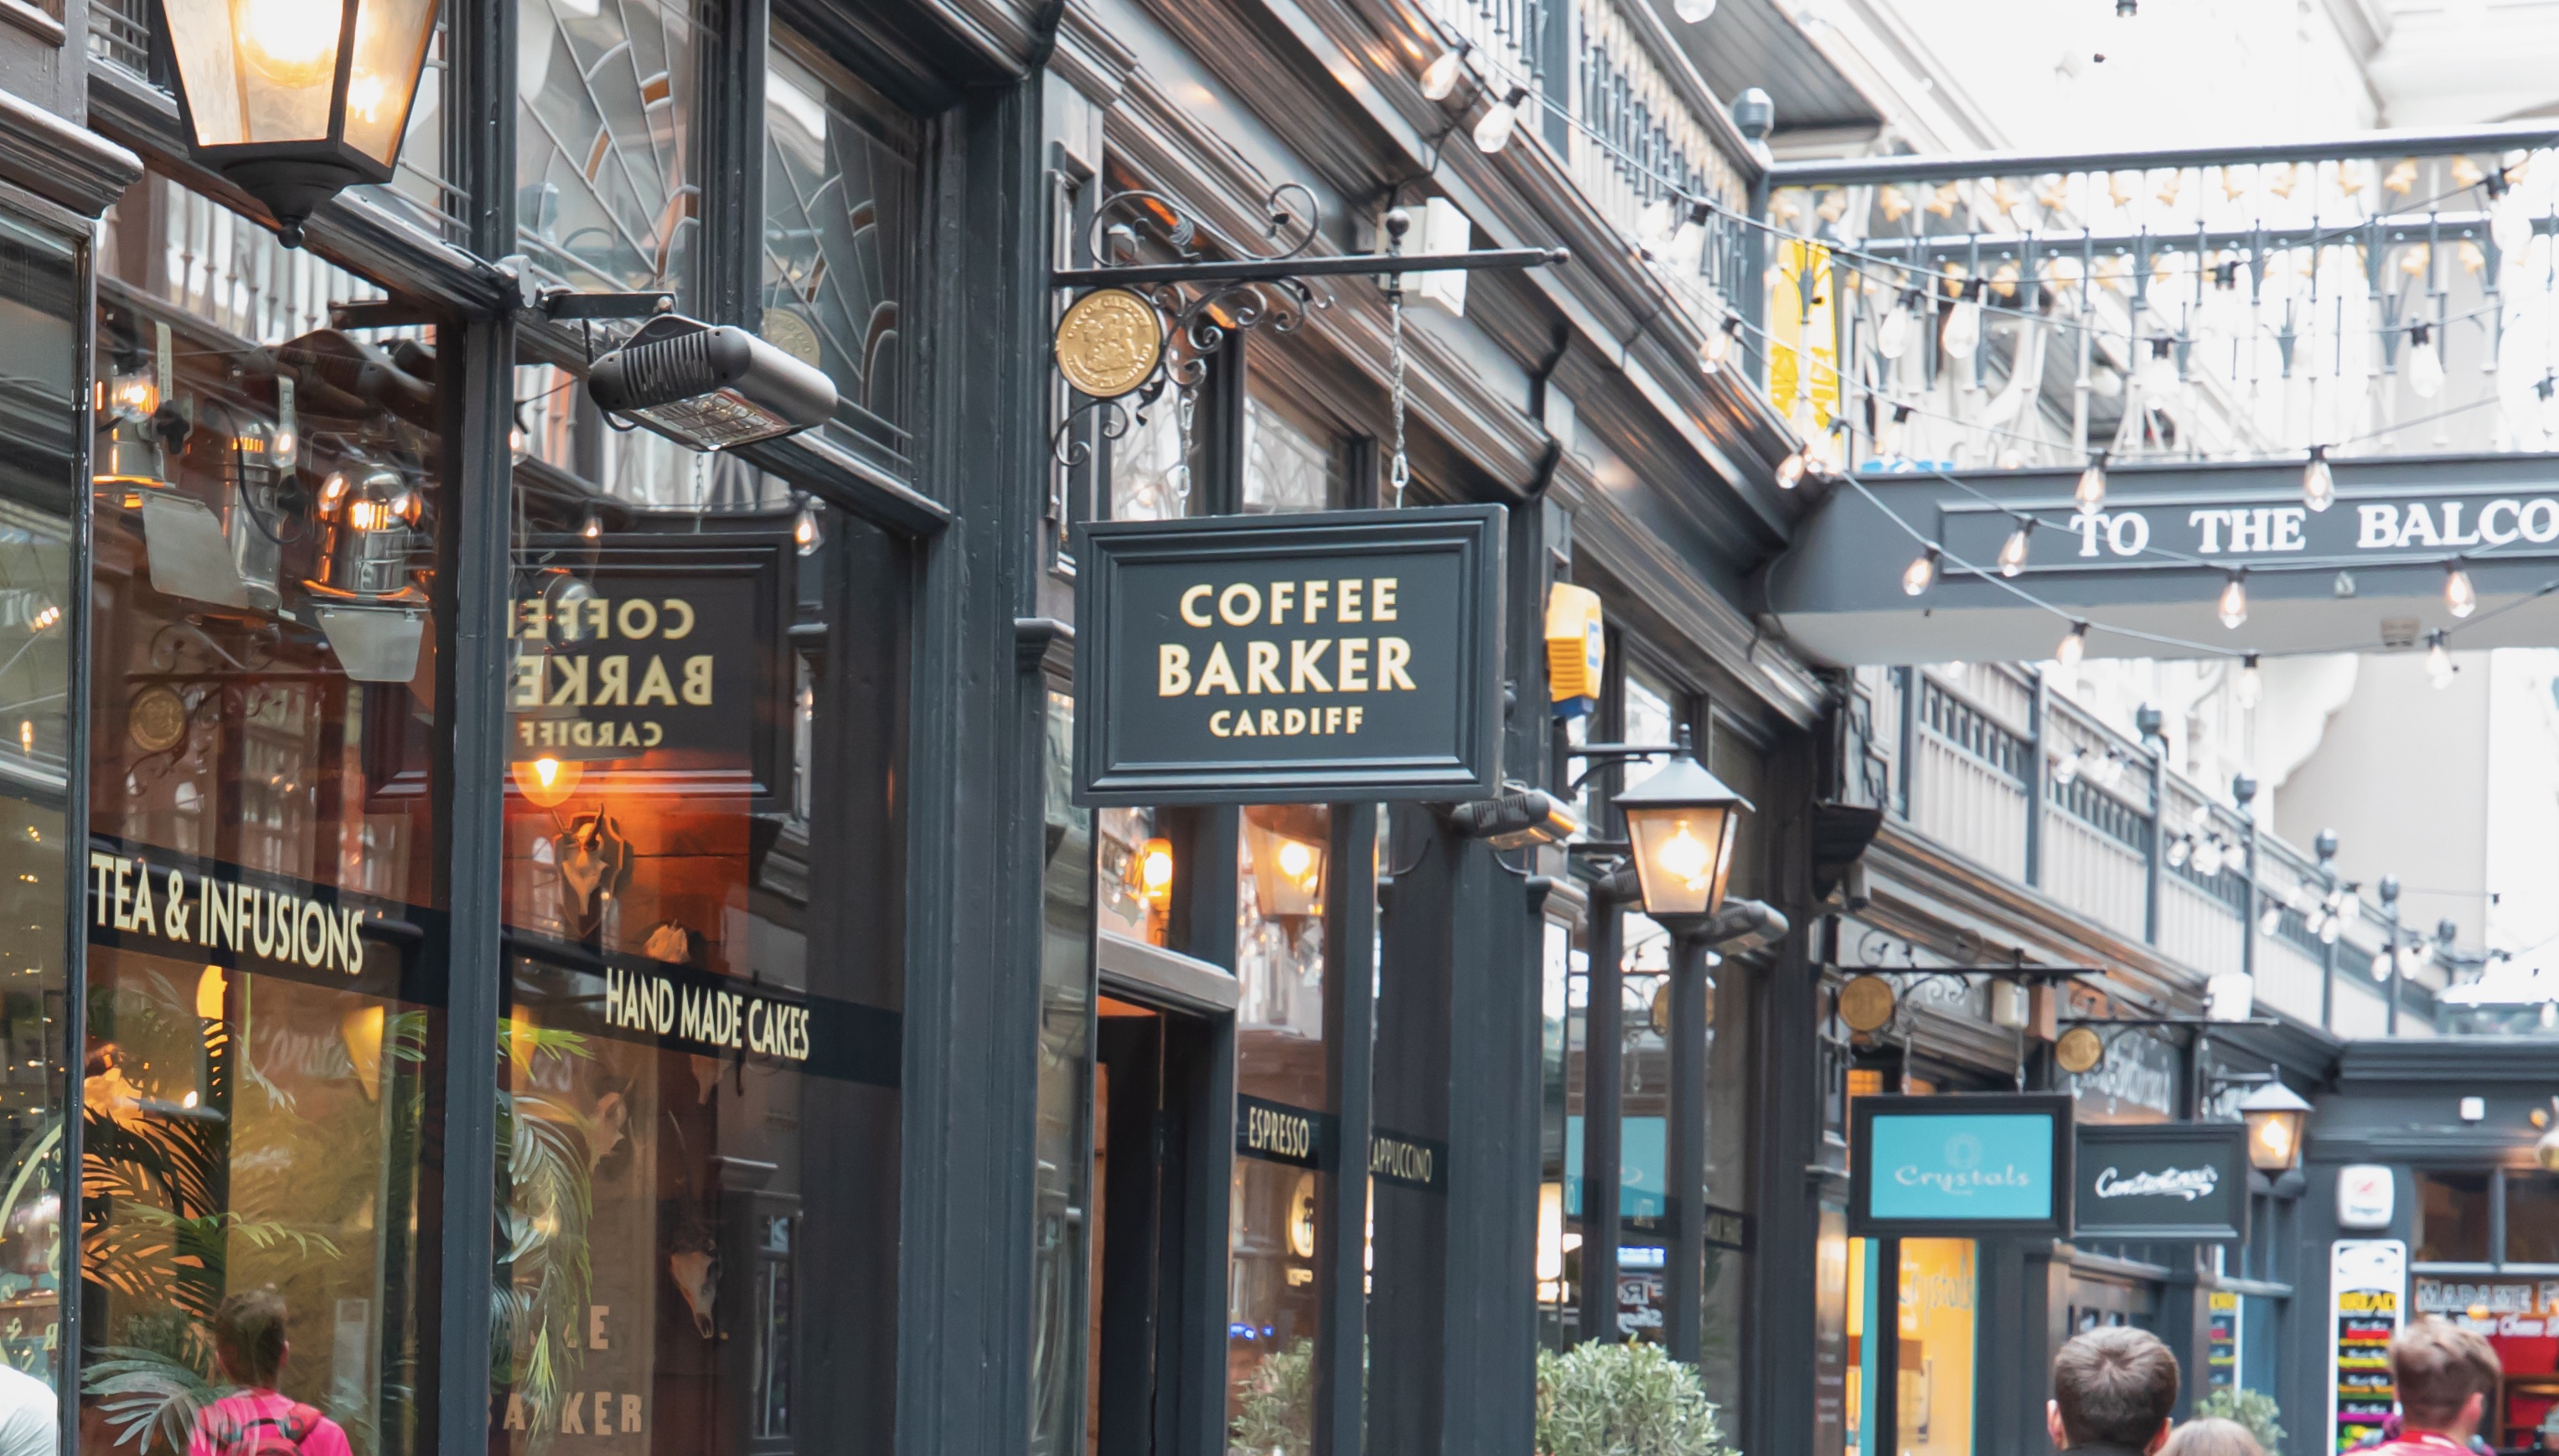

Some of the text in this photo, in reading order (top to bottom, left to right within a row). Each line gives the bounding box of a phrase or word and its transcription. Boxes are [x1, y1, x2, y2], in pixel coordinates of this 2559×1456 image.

[2069, 498, 2559, 556] TO THE BALCO
[1180, 578, 1398, 628] COFFEE
[1158, 637, 1417, 697] BARKER
[1209, 705, 1363, 737] CARDIFF
[90, 850, 364, 976] TEA & INFUSIONS
[605, 967, 810, 1061] HAND MADE CAKES
[1248, 1106, 1310, 1159] ESPRESSO
[1370, 1138, 1433, 1183] APPUCCINO
[1894, 1164, 2030, 1195] Crystals
[488, 1391, 643, 1436] AKER
